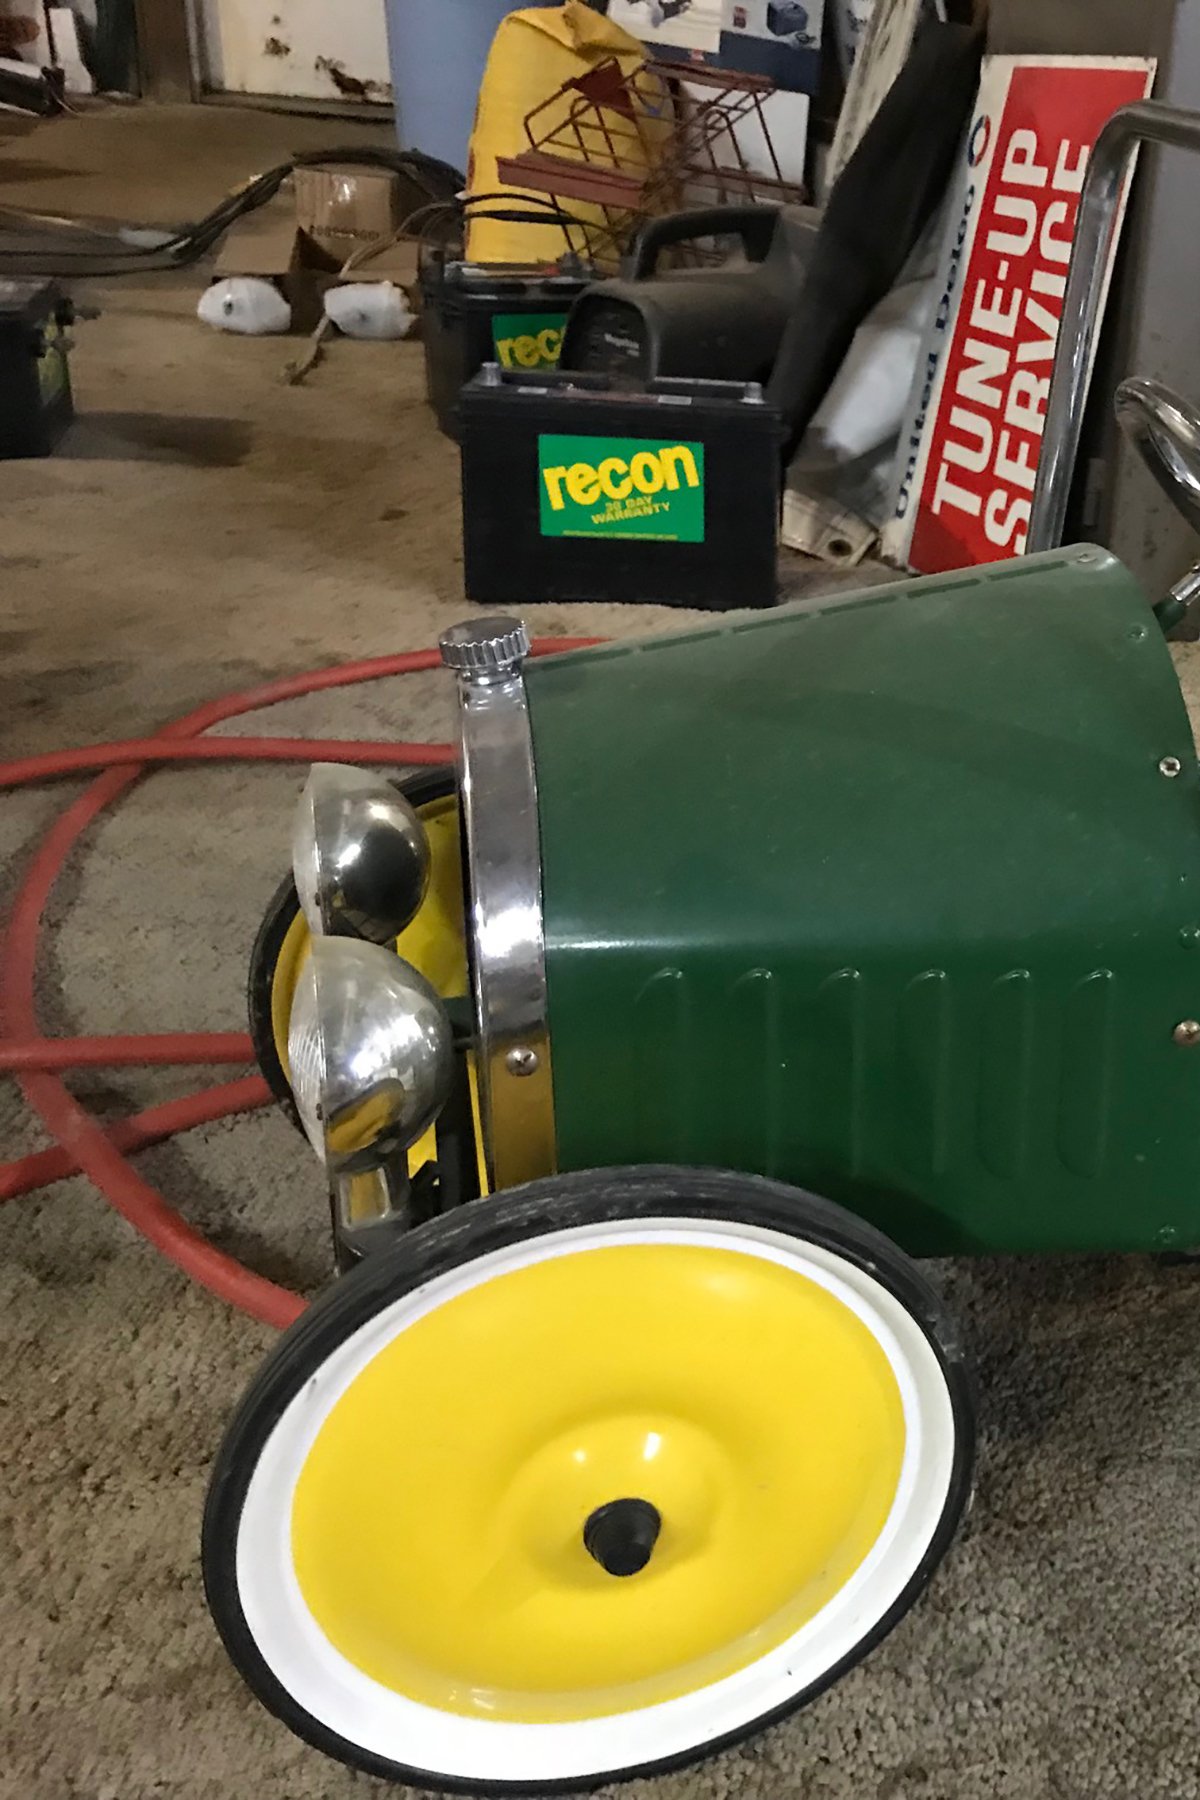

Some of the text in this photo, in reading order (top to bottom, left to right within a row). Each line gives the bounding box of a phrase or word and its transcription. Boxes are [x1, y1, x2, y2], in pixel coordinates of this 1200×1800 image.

[496, 326, 566, 368] rec
[895, 184, 975, 519] United Delco
[931, 128, 1048, 517] TUNE-UP
[984, 138, 1090, 556] SERVICE
[543, 445, 700, 511] recon
[591, 501, 670, 525] WARRANTY
